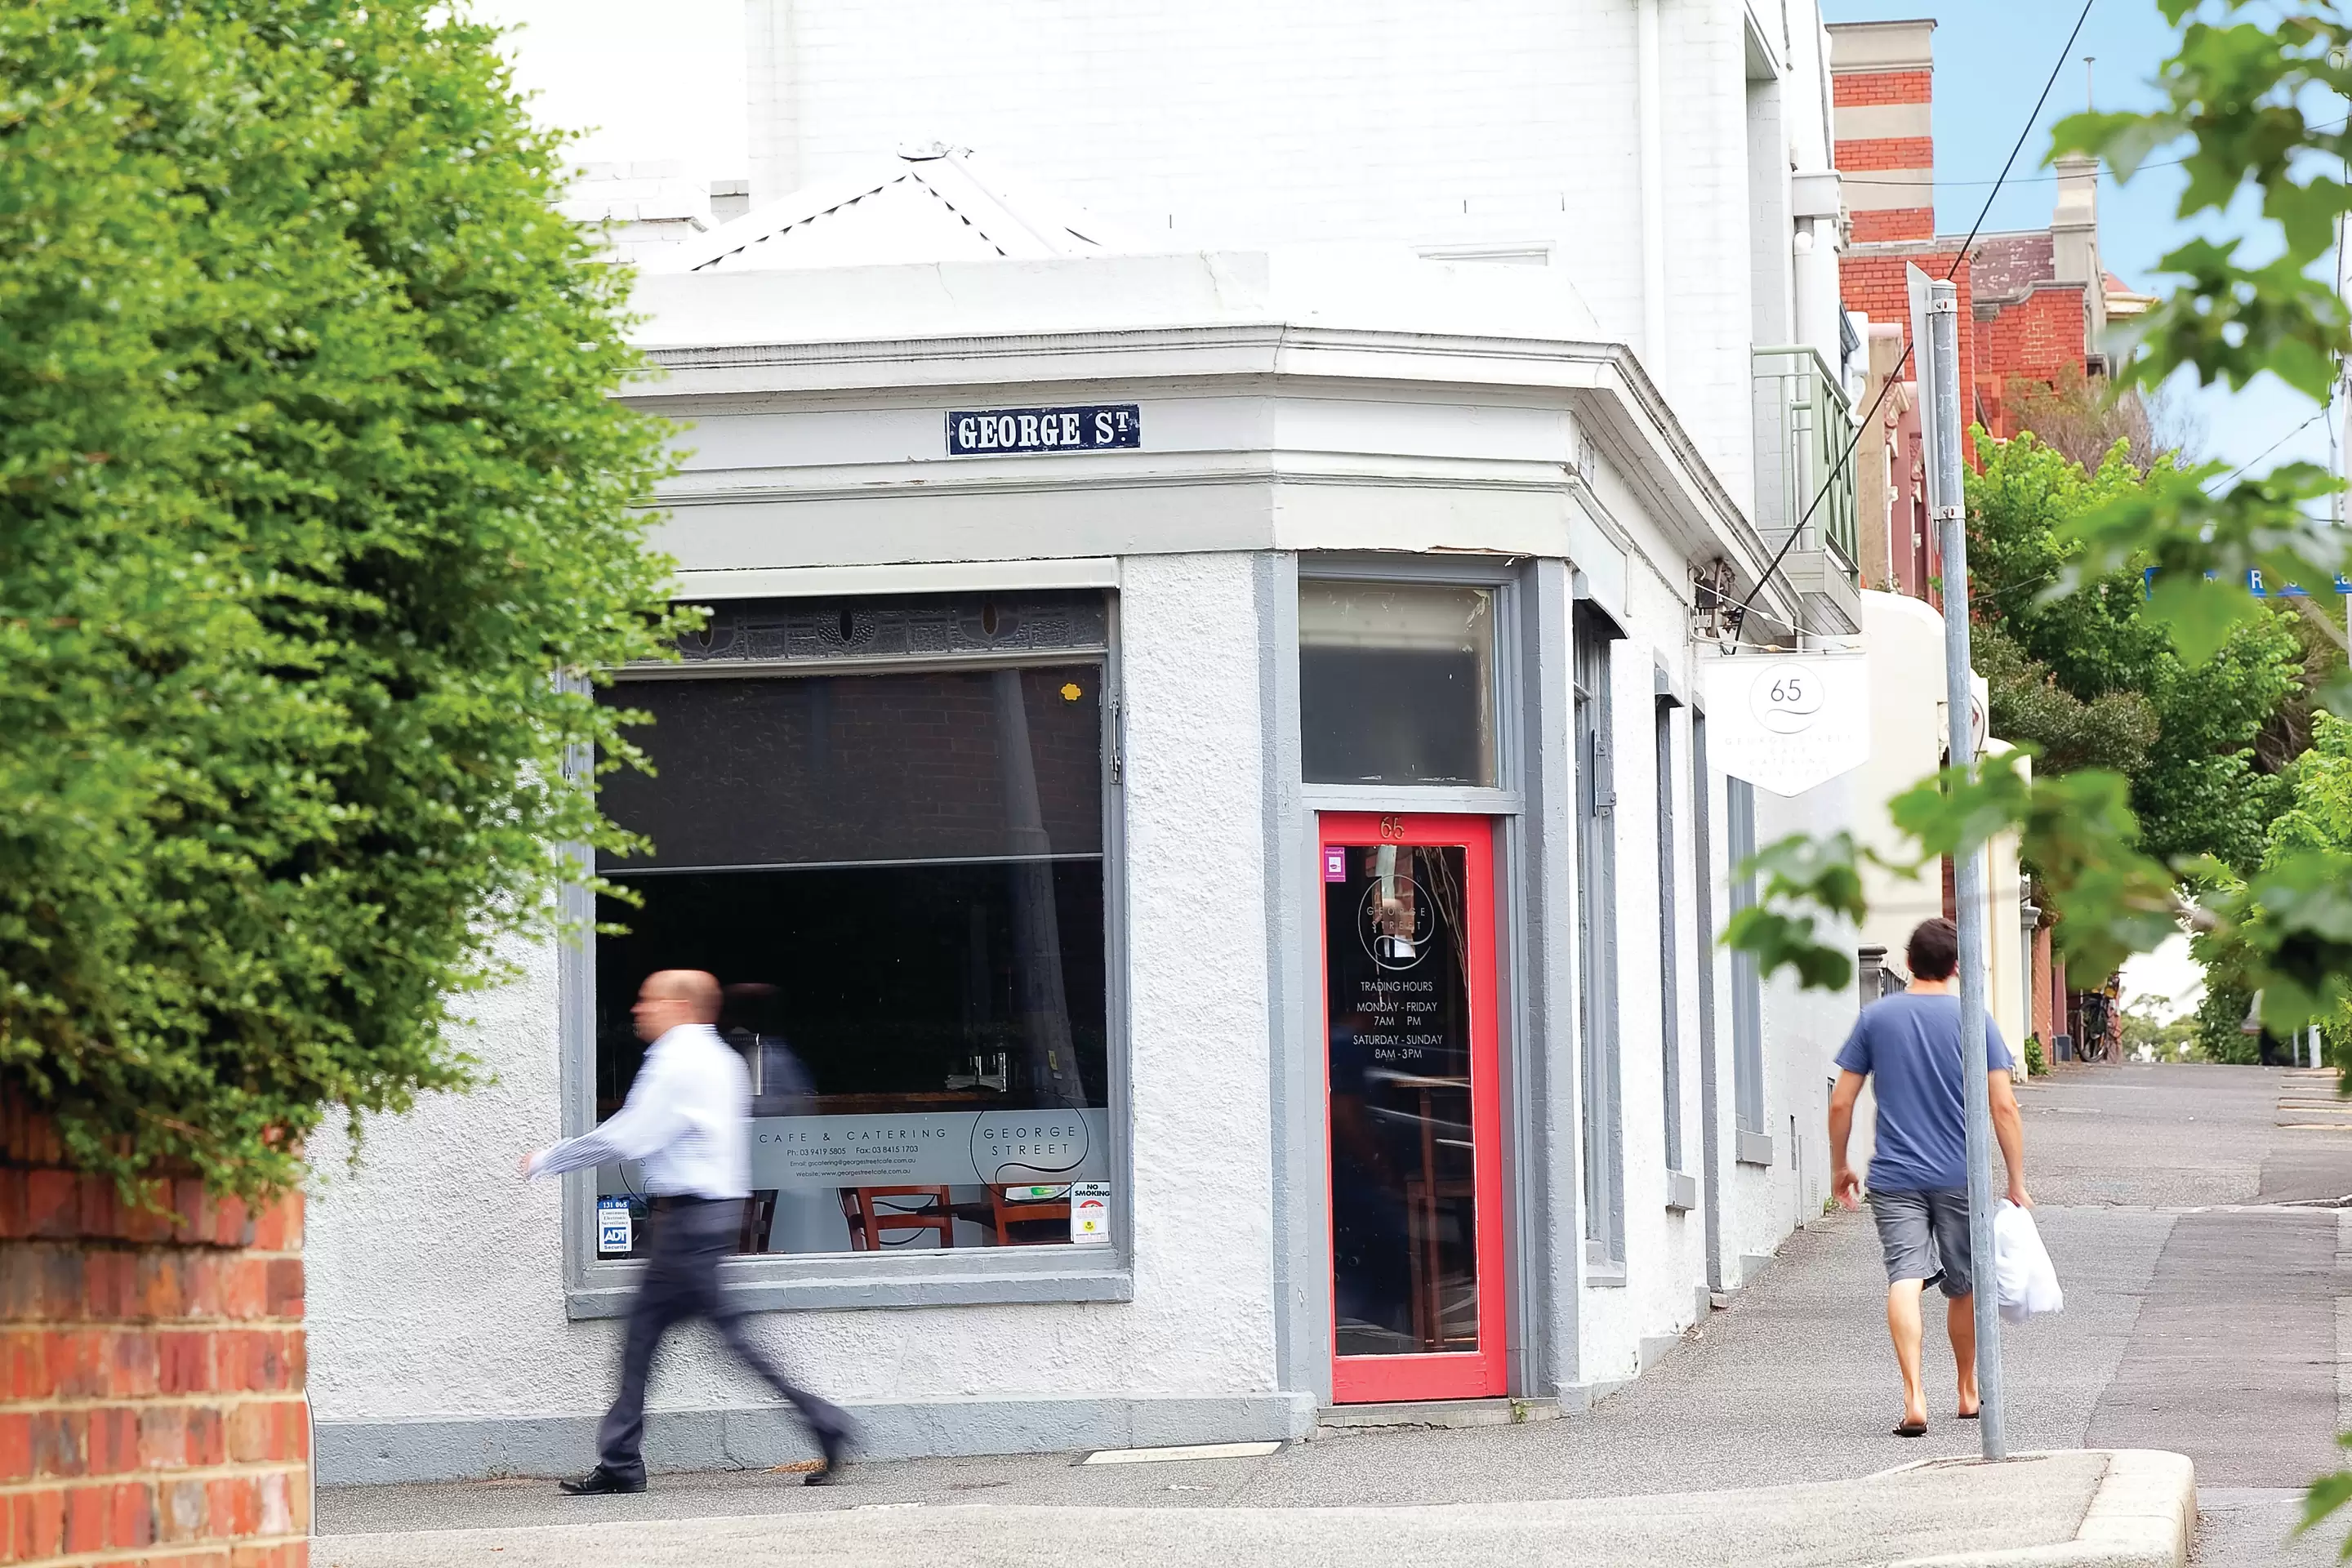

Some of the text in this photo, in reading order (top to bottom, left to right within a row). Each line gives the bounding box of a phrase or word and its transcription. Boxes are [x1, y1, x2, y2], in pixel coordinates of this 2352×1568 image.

[958, 412, 1080, 449] GEORGE
[1771, 679, 1802, 702] 65
[1380, 817, 1405, 840] 65
[1366, 906, 1426, 916] GEORGE
[1371, 920, 1421, 930] STREET
[1360, 981, 1433, 992] TRADING HOURS
[1356, 1001, 1399, 1012] MONDAY
[1406, 1001, 1437, 1012] FRIDAY
[1374, 1016, 1422, 1026] 7AM PM
[1352, 1035, 1400, 1045] SATURDAY
[1406, 1034, 1443, 1045] SUNDAY
[1374, 1049, 1396, 1059] 8AM
[759, 1128, 947, 1143] CAFE & CATERING
[983, 1126, 1076, 1139] GEORGE
[871, 1146, 881, 1154] 03
[902, 1145, 919, 1153] 1703
[991, 1143, 1068, 1156] STREET
[808, 1157, 916, 1168] gscatering@georgestreetcafe.com.au
[821, 1168, 911, 1177] www.georgestreetcafe.com.au
[604, 1229, 626, 1242] ADT
